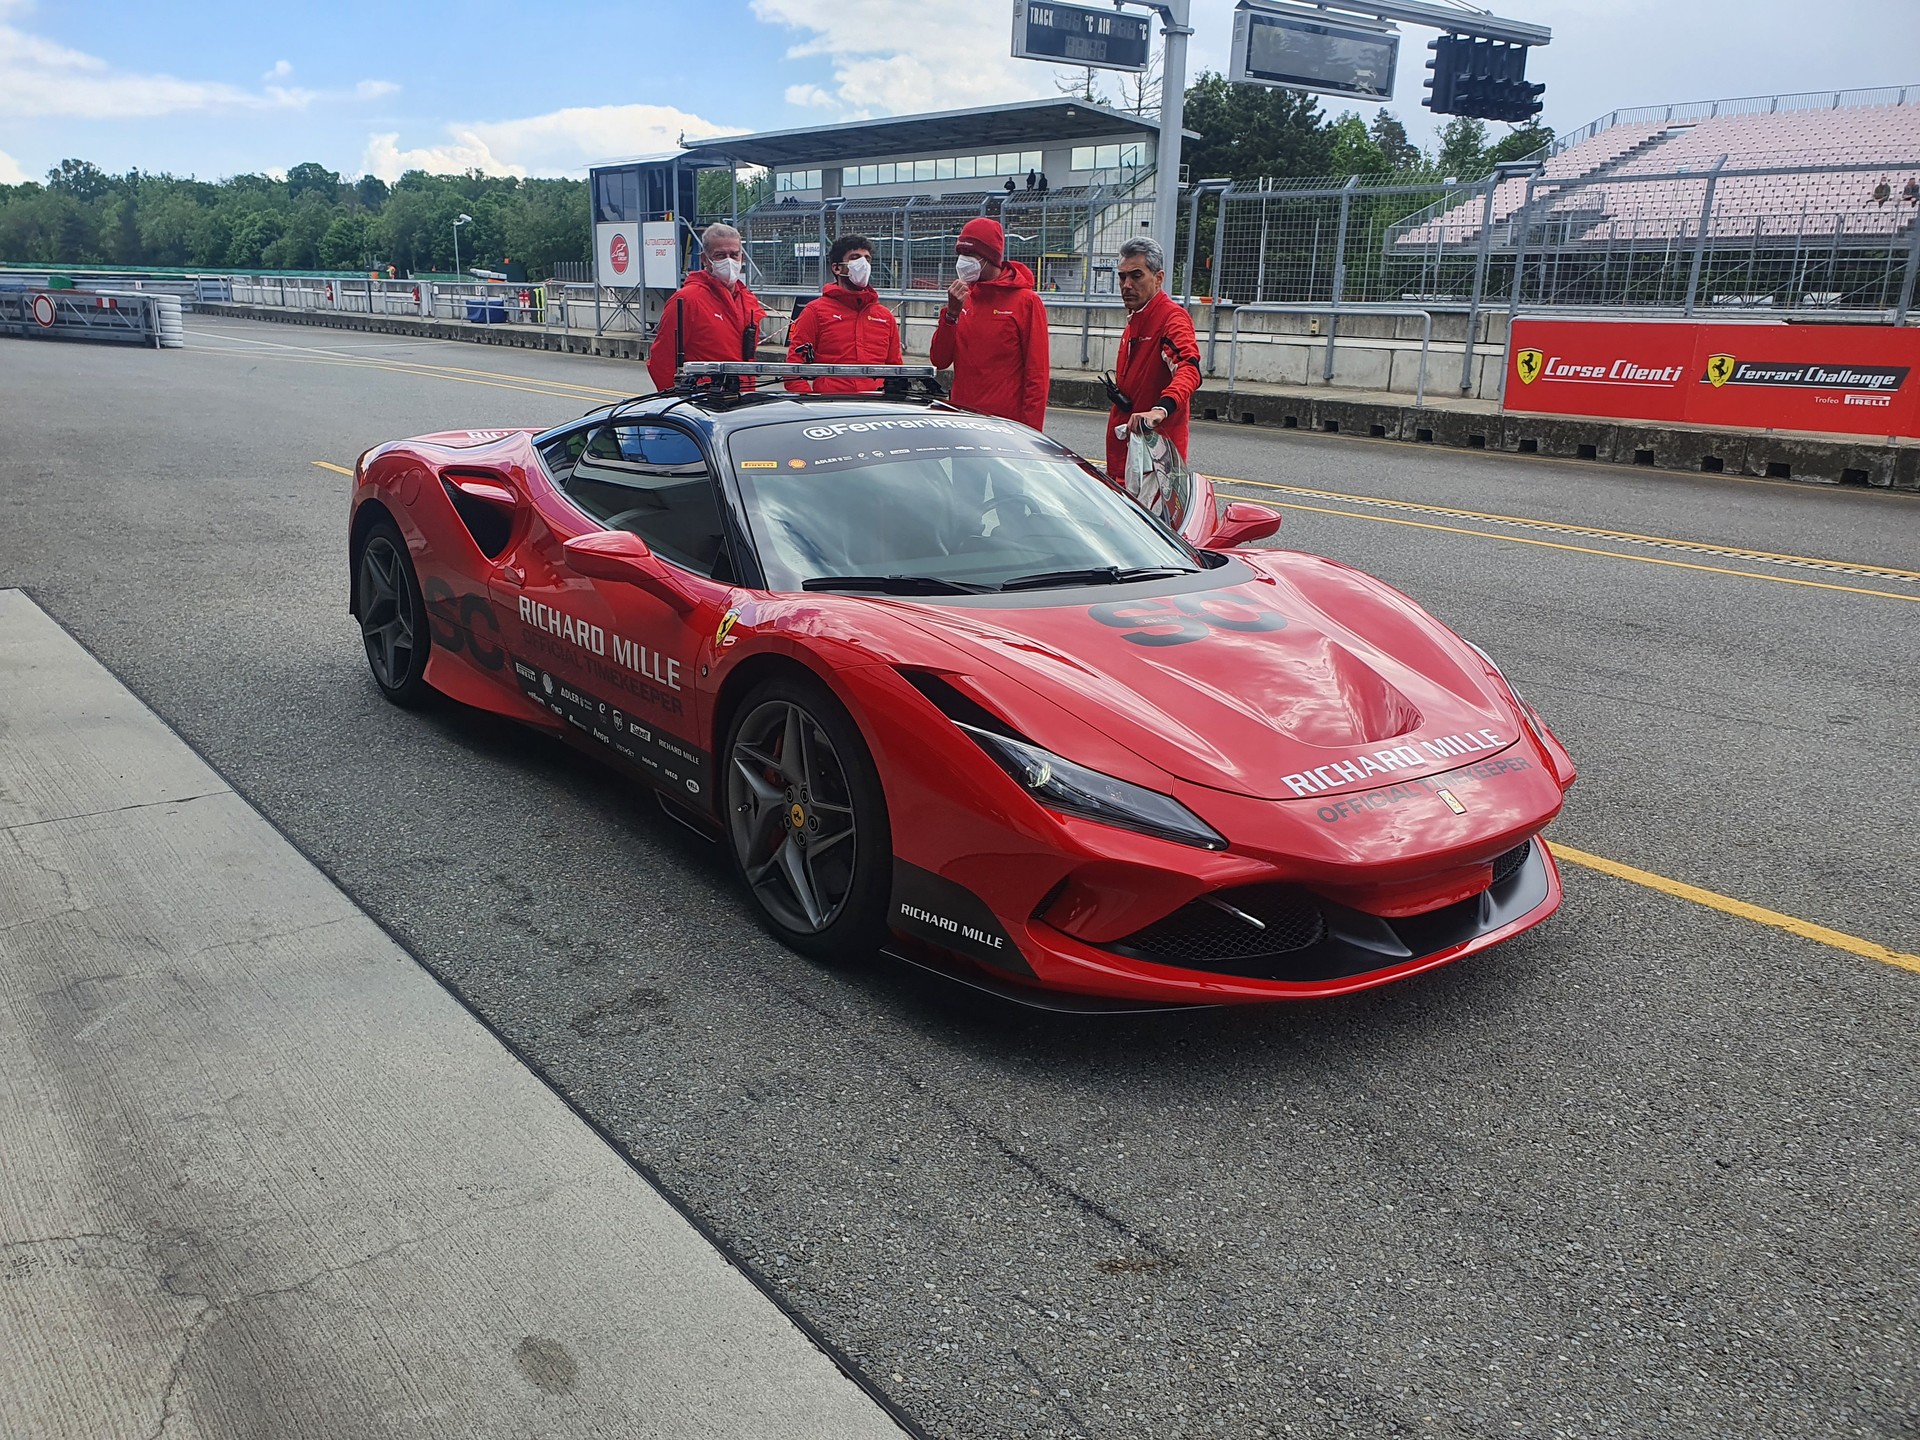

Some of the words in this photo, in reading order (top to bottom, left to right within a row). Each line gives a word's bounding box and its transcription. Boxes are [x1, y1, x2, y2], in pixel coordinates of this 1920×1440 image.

[1030, 7, 1054, 27] TRACK
[1097, 17, 1111, 36] AIR
[1544, 357, 1606, 378] Corse
[1609, 359, 1684, 382] Clienti
[1735, 364, 1803, 381] Ferrari
[1804, 366, 1896, 388] Challenge
[1814, 396, 1840, 404] Trofeo
[1844, 394, 1891, 407] PIRELLI
[803, 418, 1016, 441] @FerrariRaces
[424, 575, 505, 671] SC
[1088, 591, 1288, 647] SC
[518, 595, 605, 657] RICHARD
[613, 633, 681, 691] MILLE
[515, 662, 536, 682] PIRELLI
[521, 628, 583, 669] OFFICIAL
[583, 656, 683, 717] TIMEKEEPER
[561, 687, 580, 705] ADLER
[658, 739, 682, 756] RICHARD
[682, 750, 700, 766] MILLE
[1281, 744, 1426, 797] RICHARD
[1420, 728, 1507, 760] MILLE
[1316, 784, 1422, 824] OFFICIAL
[1415, 756, 1534, 795] TIMEKEEPER
[901, 903, 958, 933] RICHARD
[961, 925, 1004, 950] MILLE
